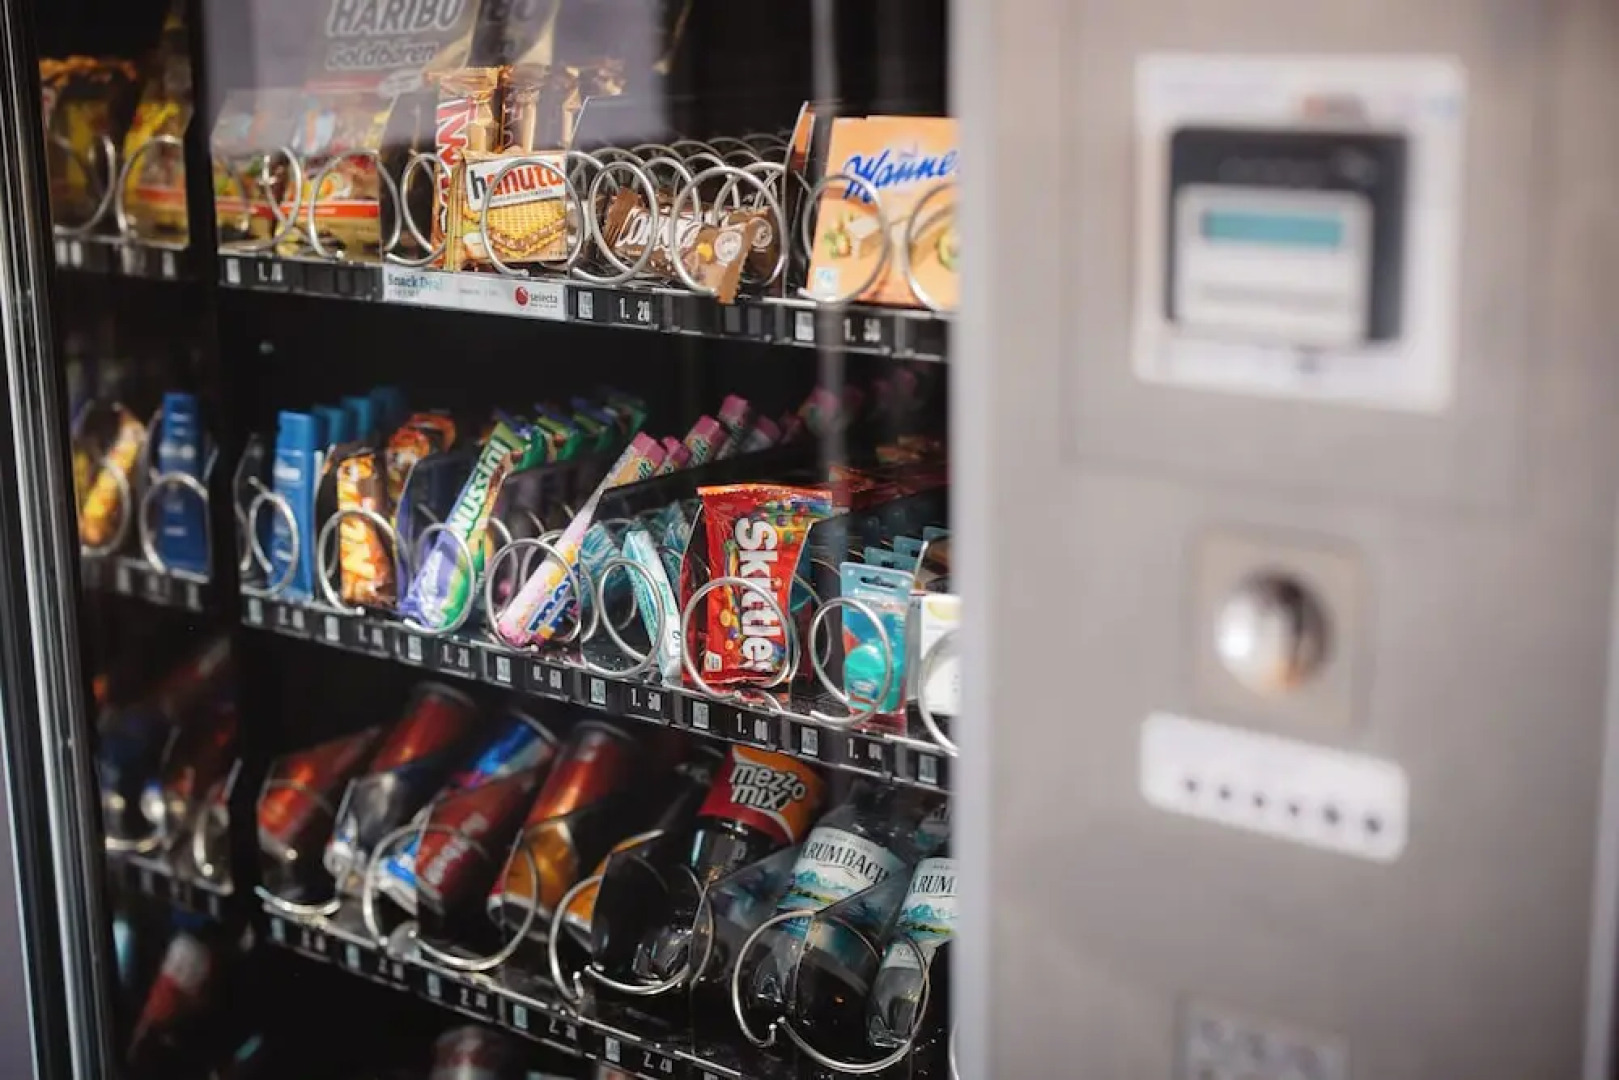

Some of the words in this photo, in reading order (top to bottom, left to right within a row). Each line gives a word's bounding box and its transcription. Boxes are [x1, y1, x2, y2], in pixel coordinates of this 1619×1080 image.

[327, 0, 464, 37] HARIBO
[843, 149, 958, 204] Manne
[730, 764, 806, 800] mezzo
[731, 784, 790, 811] mix
